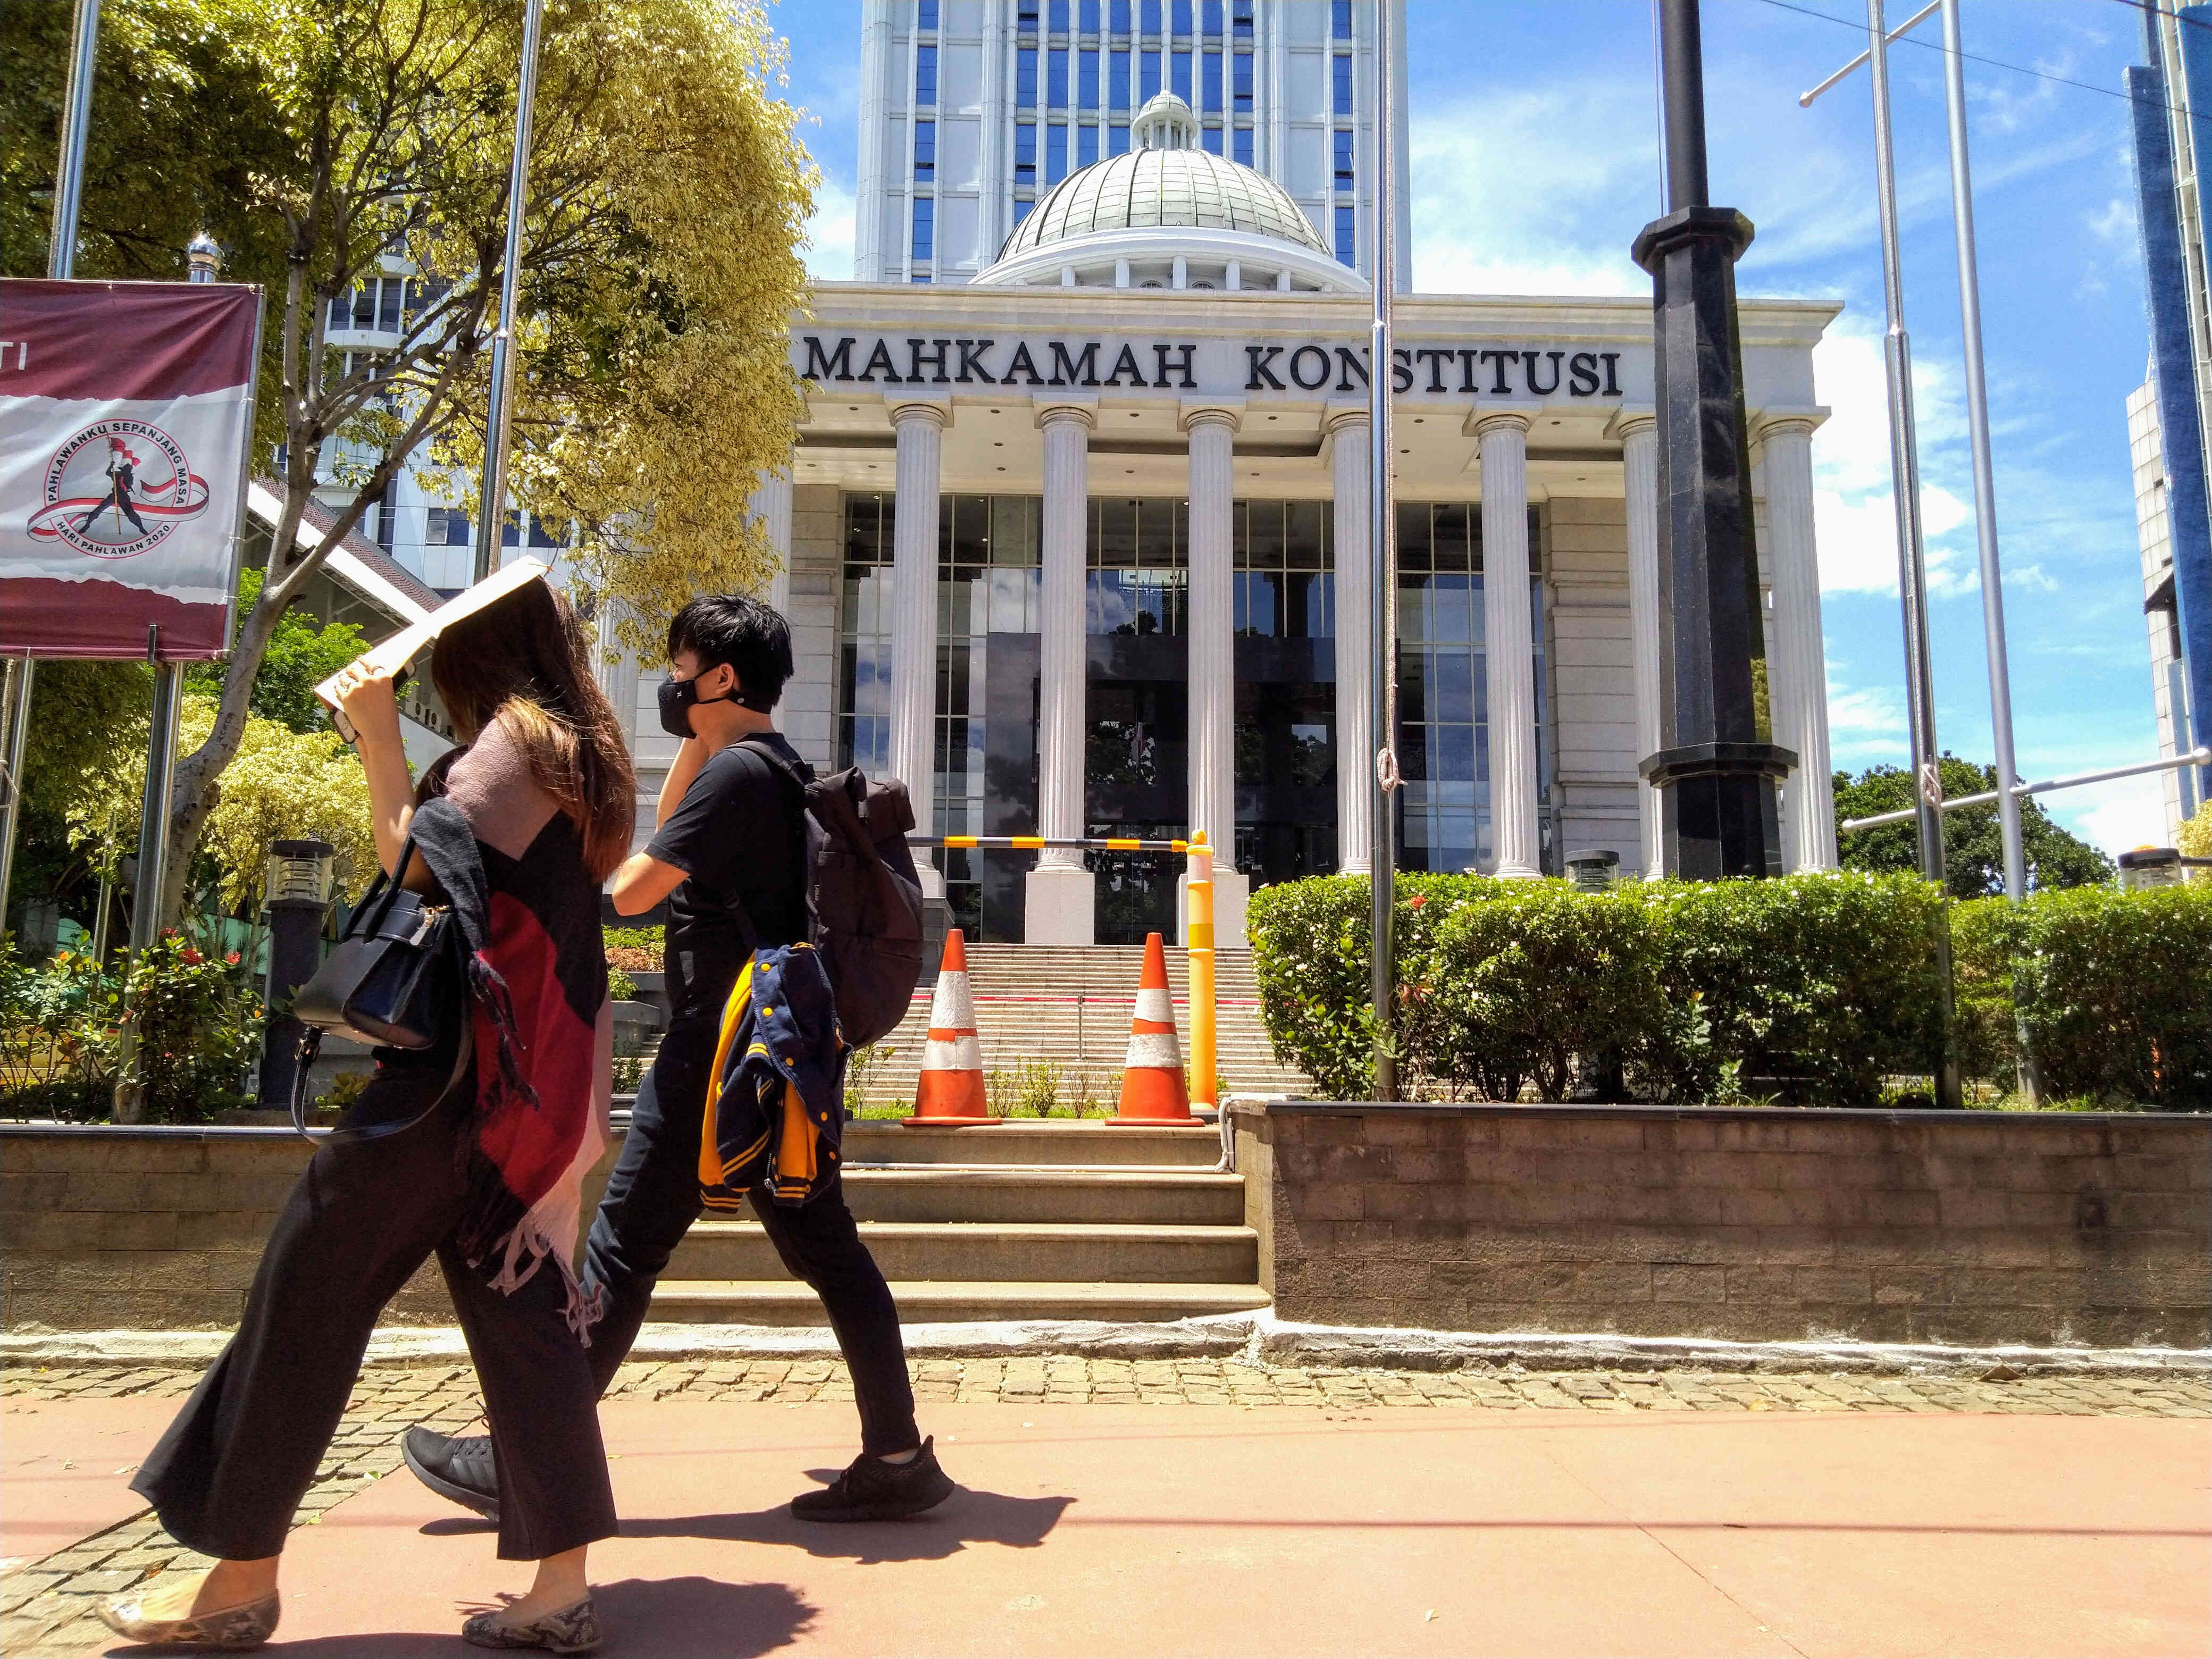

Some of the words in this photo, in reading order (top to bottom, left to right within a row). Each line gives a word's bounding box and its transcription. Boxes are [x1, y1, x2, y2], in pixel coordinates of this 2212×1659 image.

[801, 336, 1197, 388] MAHKAMAH
[1244, 345, 1623, 397] KONSTITUSI
[48, 425, 107, 502] PAHLAWANKU
[112, 423, 182, 465] SEPANJANG
[176, 467, 187, 505] MASA
[56, 521, 80, 544] HARI
[80, 541, 144, 555] PAHLAWAN
[146, 525, 171, 545] 2020
